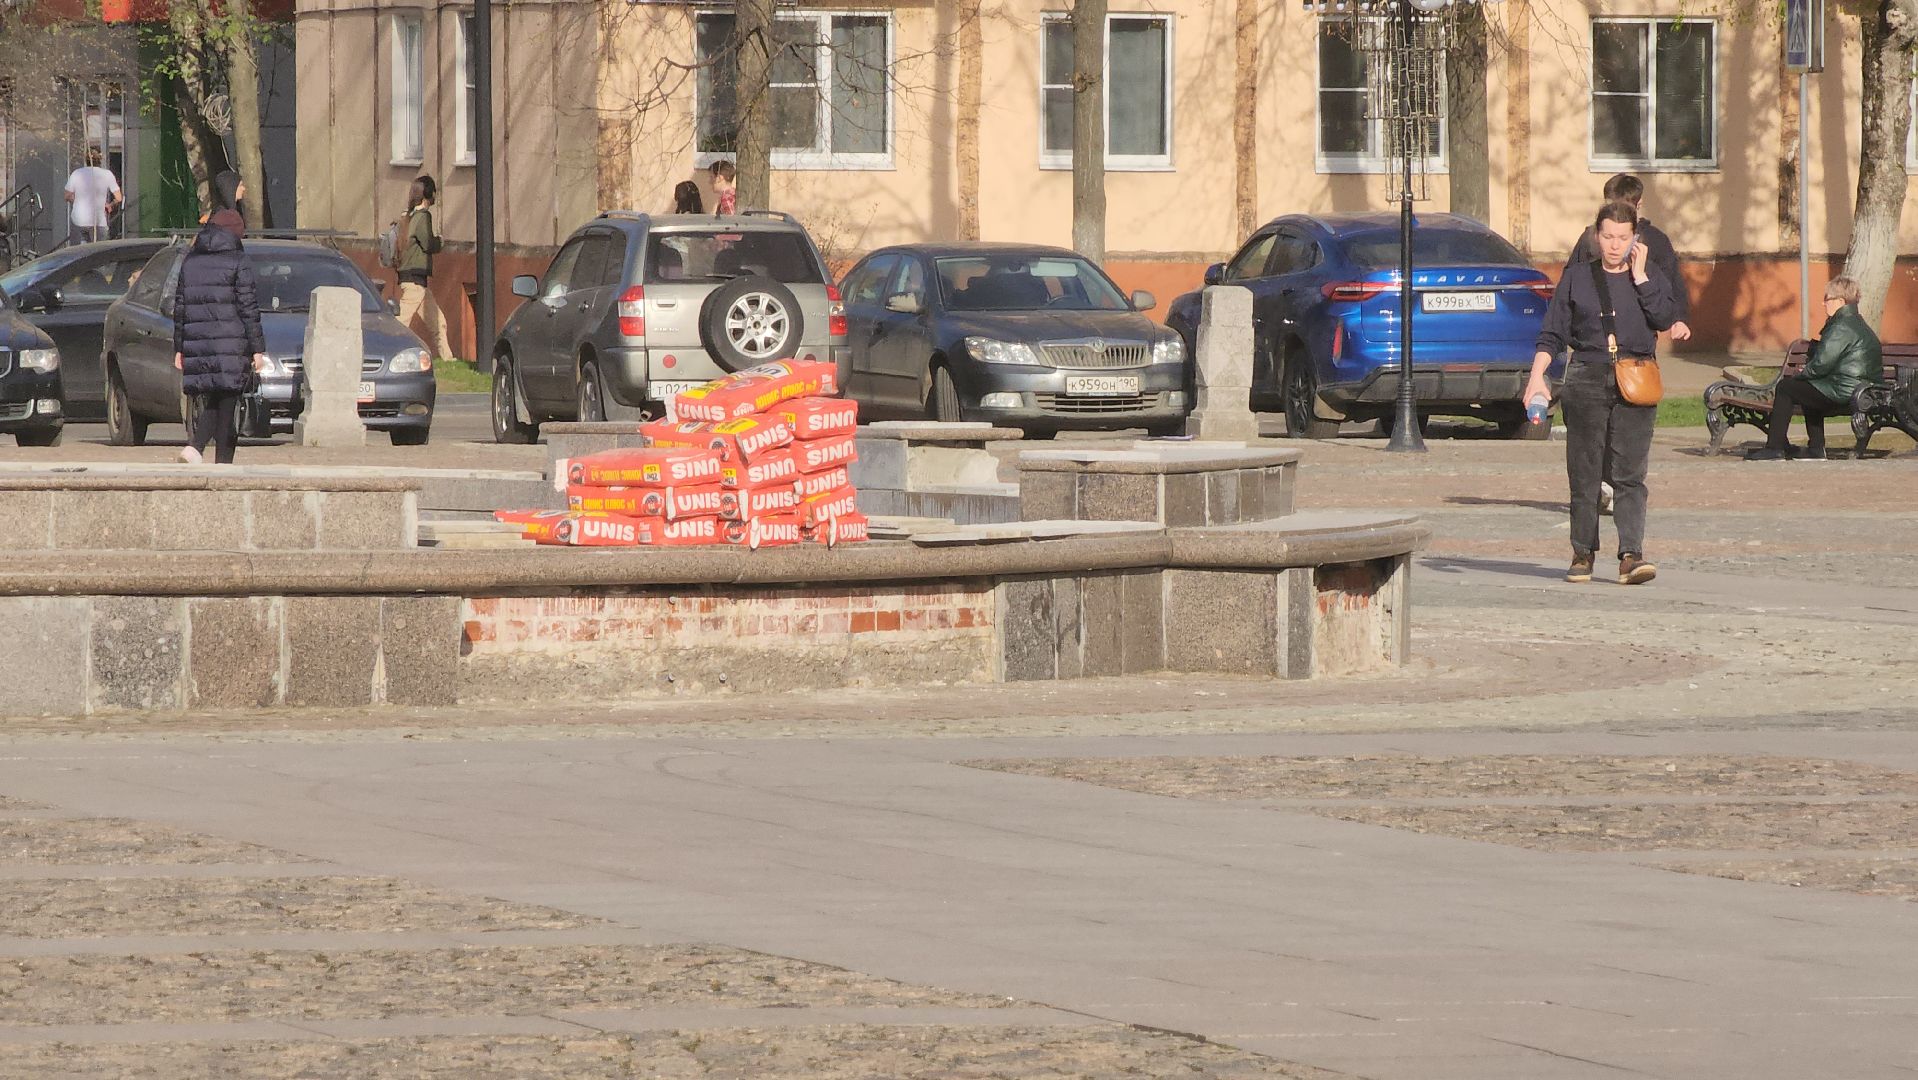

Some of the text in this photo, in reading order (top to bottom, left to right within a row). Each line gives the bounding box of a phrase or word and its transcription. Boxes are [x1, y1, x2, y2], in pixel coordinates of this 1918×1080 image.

[1418, 275, 1501, 283] HAVAL
[1475, 295, 1492, 304] 150
[678, 403, 726, 421] UNIS
[808, 410, 855, 430] UNIS
[742, 423, 788, 454] UNIS
[806, 440, 854, 466] UNIS
[671, 457, 720, 479] UNIS
[748, 458, 796, 483] UNIS
[806, 469, 847, 495] UNIS
[678, 492, 721, 511] UNIS
[753, 491, 794, 510] UNIS
[816, 496, 855, 522] UNIS
[583, 520, 635, 542] UNIS
[664, 520, 715, 538] UNIS
[760, 524, 799, 540] UNIS
[840, 523, 868, 539] UNIS
